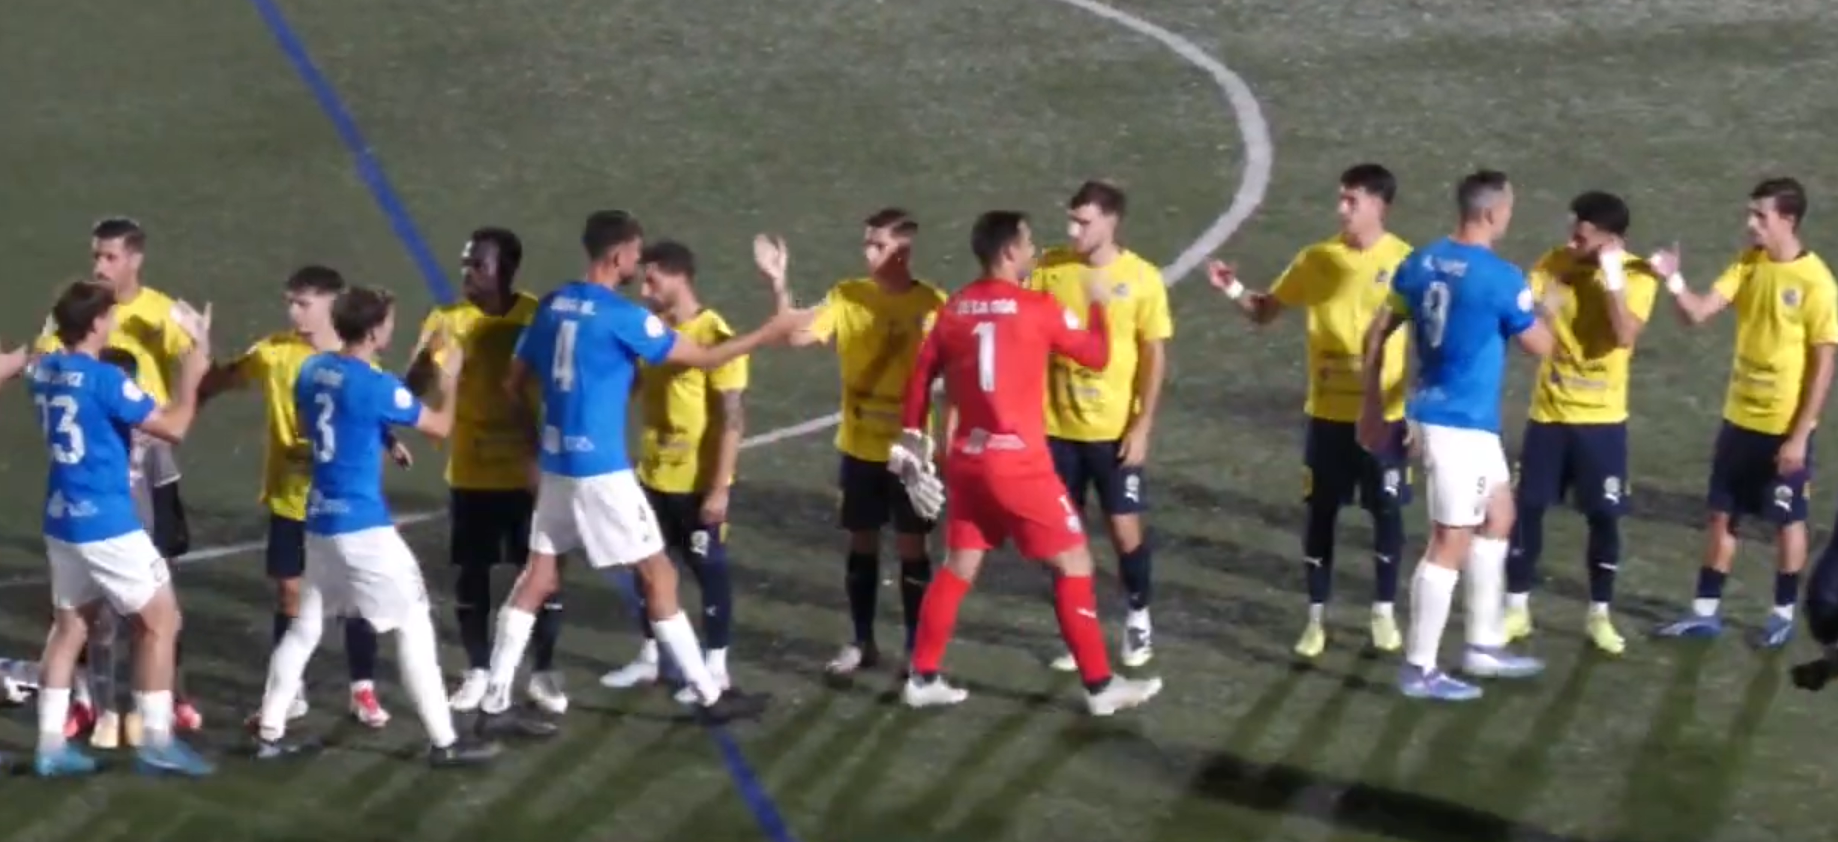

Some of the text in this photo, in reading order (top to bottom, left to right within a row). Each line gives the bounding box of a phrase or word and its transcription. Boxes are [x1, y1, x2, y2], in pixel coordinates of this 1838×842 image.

[1423, 281, 1450, 348] 9
[552, 320, 578, 392] 4
[971, 321, 995, 392] 1
[314, 393, 335, 462] 3
